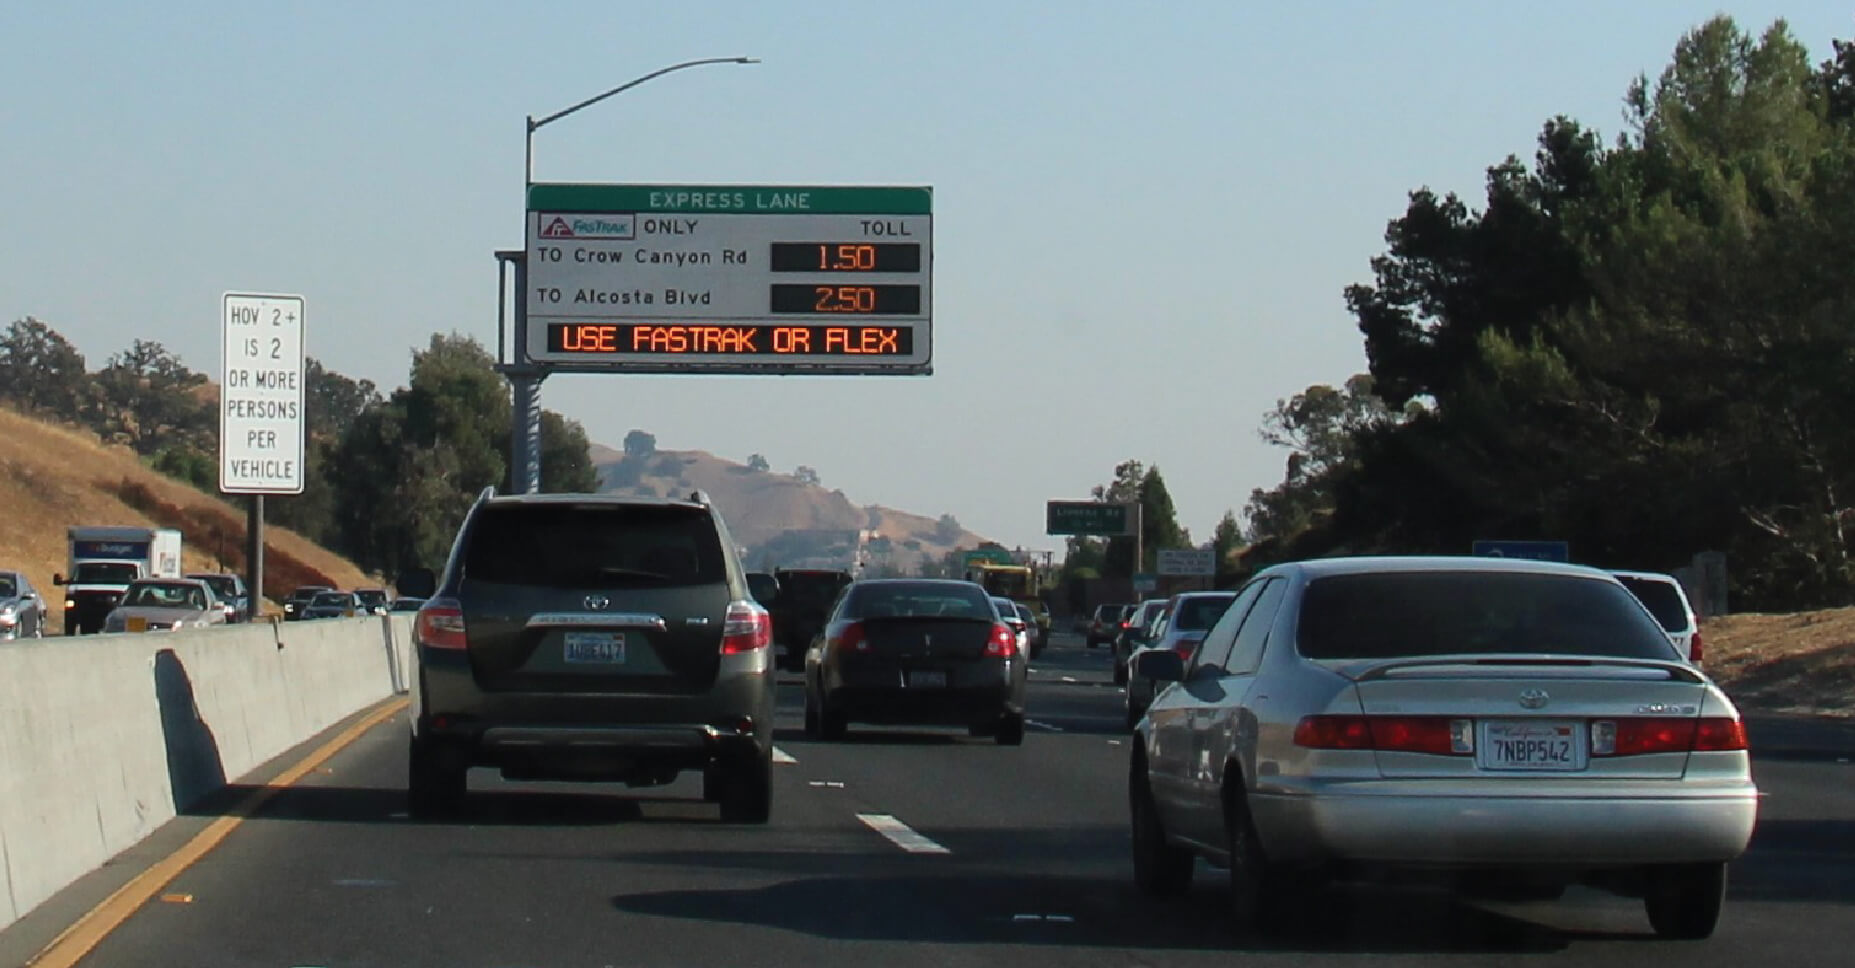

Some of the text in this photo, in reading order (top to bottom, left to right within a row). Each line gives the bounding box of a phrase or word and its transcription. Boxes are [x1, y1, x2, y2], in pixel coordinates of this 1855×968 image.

[650, 192, 811, 210] EXPRESS LANE
[644, 219, 698, 235] ONLY
[860, 220, 912, 236] TOLL
[538, 247, 747, 267] TO Crow Canyon Rd
[819, 245, 875, 270] 1.50
[537, 288, 711, 305] TO Alcosta Blvd
[815, 286, 875, 312] 2.50
[231, 306, 260, 325] HOV
[244, 337, 281, 359] IS 2
[563, 326, 898, 354] USE FASTRAK OR FLEX
[229, 369, 297, 390] OR MORE
[227, 400, 297, 419] PERSONS
[247, 429, 276, 449] PER
[230, 459, 294, 478] VEHICLE
[1493, 740, 1570, 762] 7NBP542
